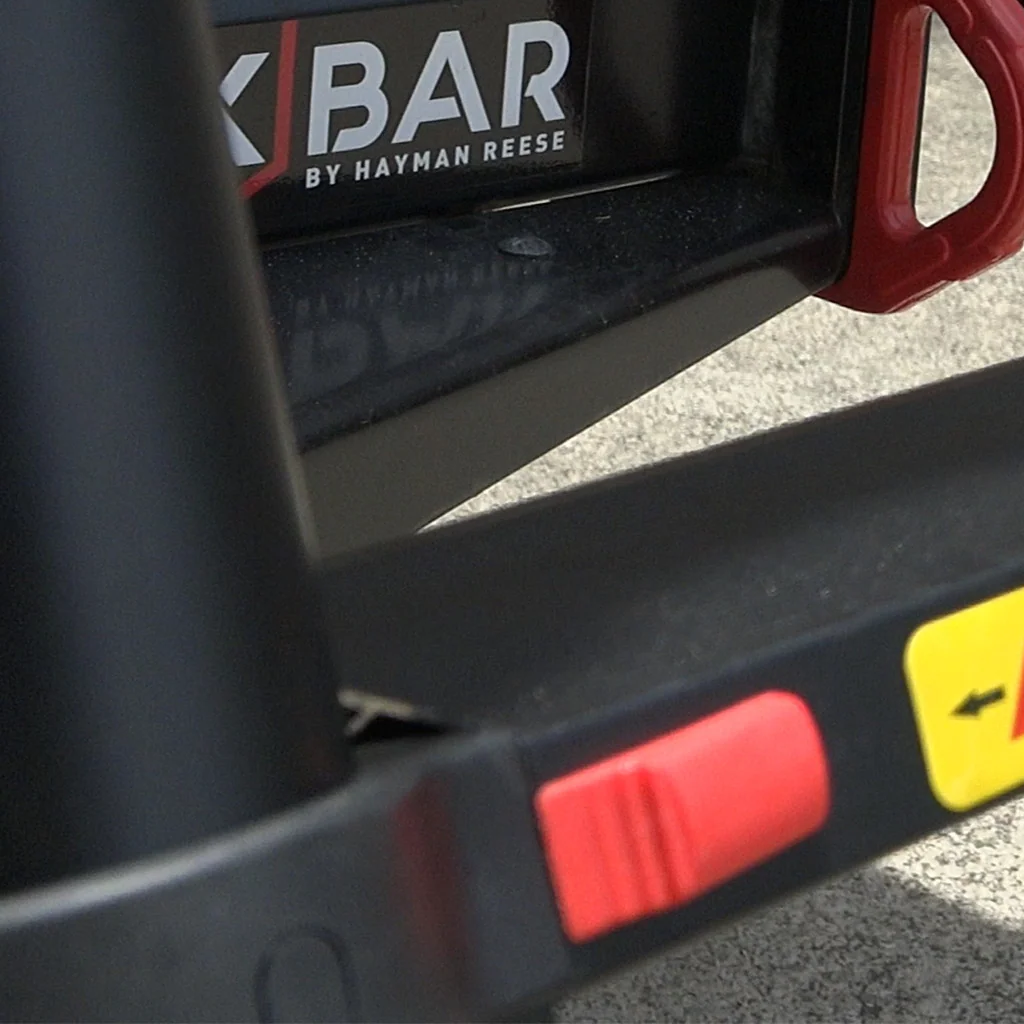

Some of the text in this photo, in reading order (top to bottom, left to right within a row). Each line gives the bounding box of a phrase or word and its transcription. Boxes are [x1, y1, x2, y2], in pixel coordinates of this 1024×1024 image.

[305, 130, 566, 189] BY HAYMAN REESE
